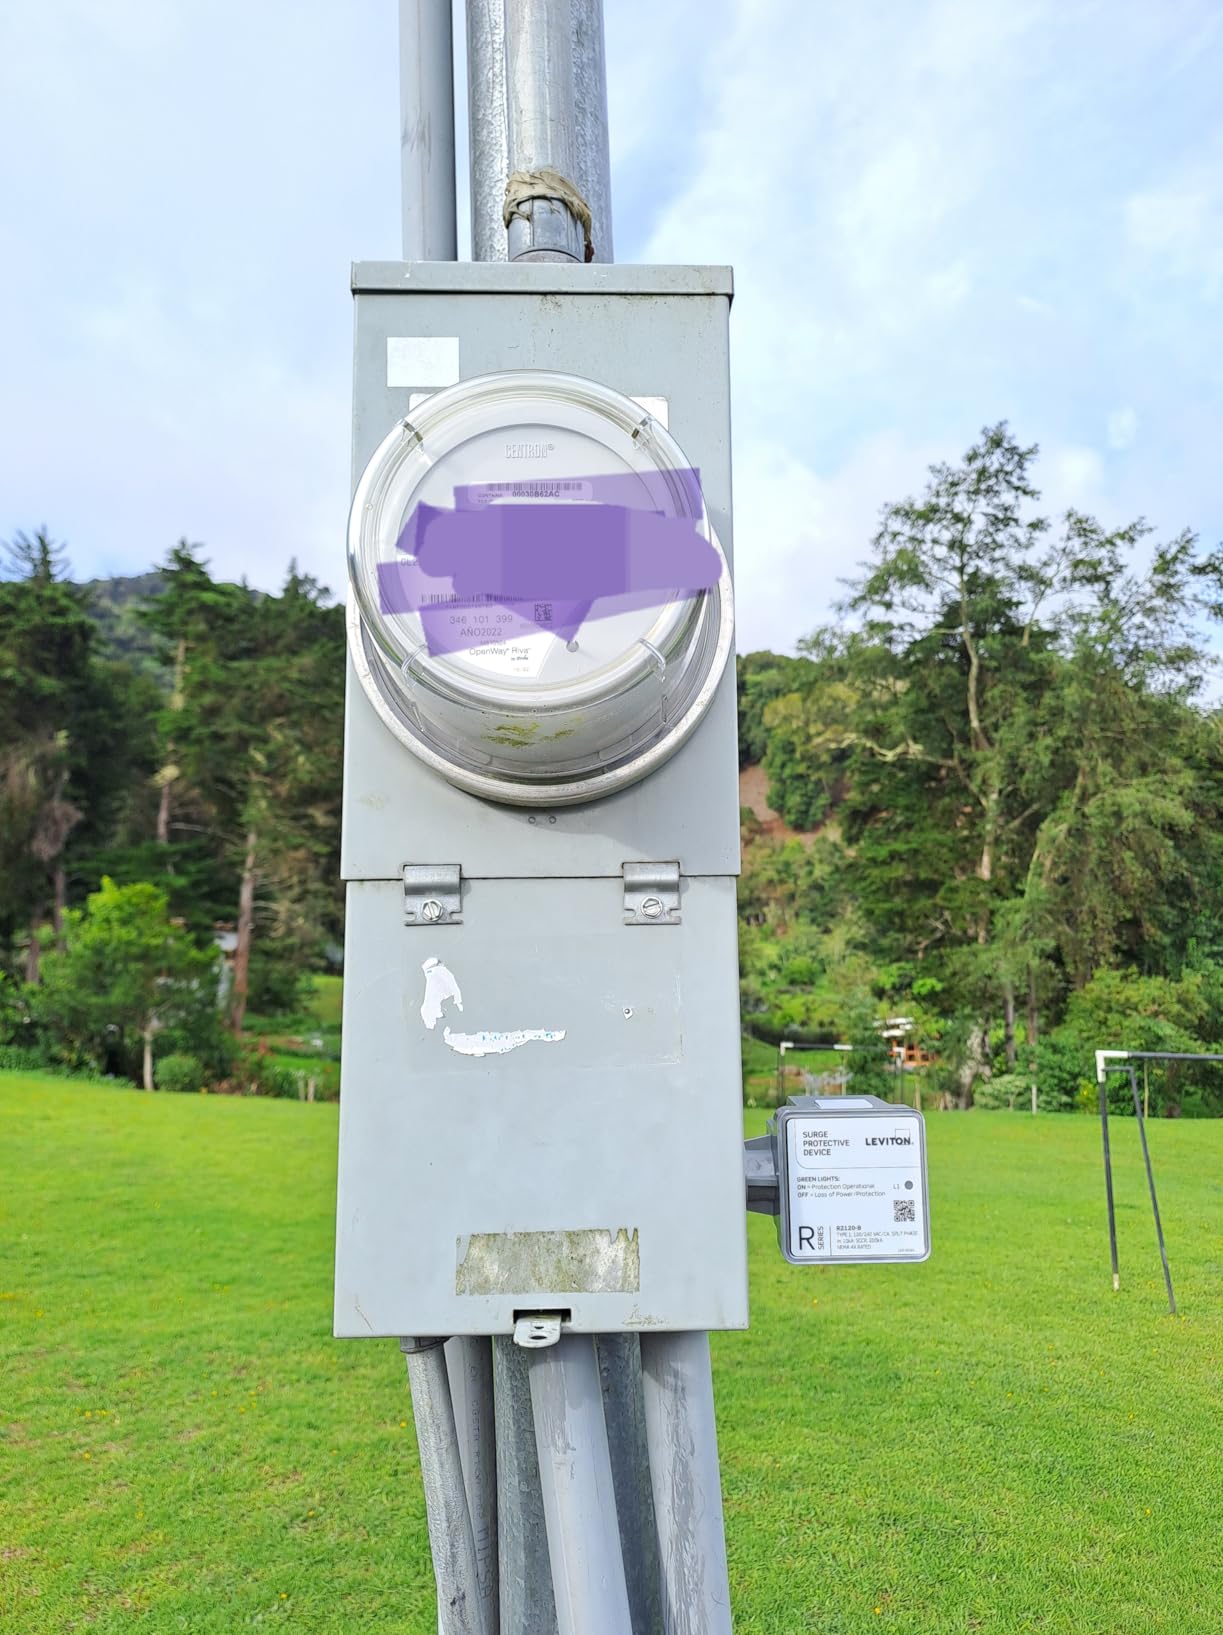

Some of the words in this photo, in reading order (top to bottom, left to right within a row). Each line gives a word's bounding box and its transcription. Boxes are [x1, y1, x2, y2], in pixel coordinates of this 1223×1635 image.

[449, 616, 467, 625] 346
[473, 615, 489, 624] 101
[496, 614, 513, 623] 399
[803, 1139, 850, 1147] PROTECTIVE
[865, 1137, 911, 1146] LEVITON
[799, 1226, 815, 1250] R
[817, 1225, 825, 1250] SERIES
